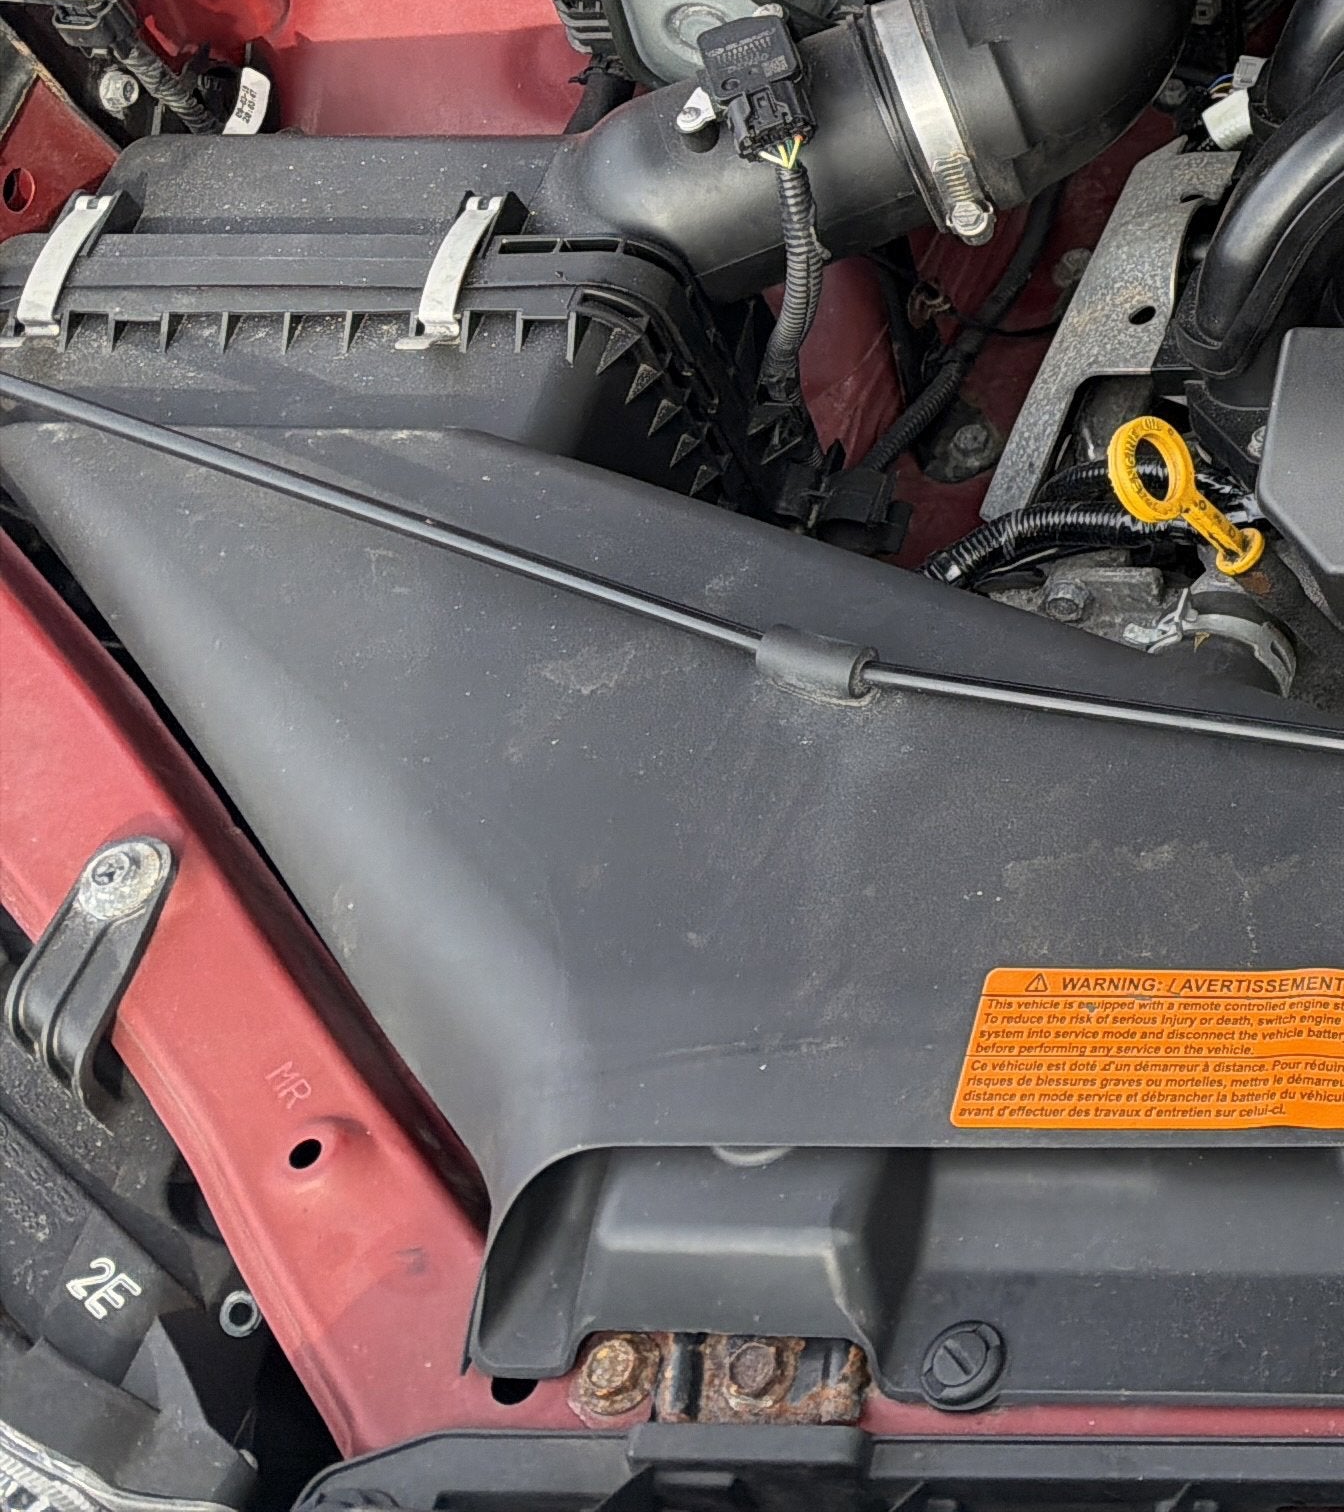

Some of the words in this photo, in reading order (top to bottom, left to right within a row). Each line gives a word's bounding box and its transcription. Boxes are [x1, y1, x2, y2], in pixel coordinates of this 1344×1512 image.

[1062, 977, 1163, 992] WARNING:
[987, 999, 1014, 1010] This
[1017, 999, 1060, 1010] vehicle
[1063, 1000, 1075, 1010] is
[1078, 999, 1136, 1012] euipped
[1138, 1000, 1164, 1011] with
[1178, 1001, 1222, 1012] remote
[1224, 1001, 1286, 1012] controlled
[1288, 999, 1331, 1013] engine
[983, 1013, 999, 1024] To
[1001, 1014, 1044, 1025] reduce
[1047, 1014, 1066, 1025] the
[1069, 1014, 1093, 1025] risk
[1096, 1014, 1110, 1025] of
[1112, 1014, 1158, 1026] serious
[1199, 1017, 1212, 1027] or
[1216, 1016, 1254, 1028] death,
[1257, 1014, 1296, 1026] switch
[1299, 1014, 1341, 1028] engine
[979, 1029, 1024, 1042] system
[1027, 1029, 1051, 1040] into
[1054, 1029, 1099, 1040] service
[1102, 1029, 1137, 1040] mode
[1140, 1029, 1164, 1040] and
[1167, 1030, 1236, 1041] disconnect
[1238, 1030, 1259, 1041] the
[1262, 1028, 1304, 1040] vehicle
[975, 1043, 1015, 1055] before
[1018, 1044, 1087, 1057] performing
[1090, 1045, 1113, 1057] any
[1115, 1044, 1161, 1055] service
[1164, 1045, 1181, 1055] on
[1184, 1045, 1204, 1055] the
[1207, 1044, 1255, 1056] vehicle.
[971, 1059, 988, 1071] Ce
[991, 1060, 1044, 1072] véhicule
[1047, 1061, 1066, 1072] est
[1069, 1060, 1098, 1072] doté
[1102, 1060, 1131, 1072] d'un
[1134, 1060, 1200, 1073] démarreur
[1213, 1060, 1269, 1074] distance.
[1271, 1059, 1302, 1072] Pour
[265, 1060, 312, 1108] MR
[966, 1075, 1013, 1088] risques
[1017, 1075, 1032, 1087] de
[1036, 1075, 1097, 1087] blessures
[1100, 1076, 1143, 1089] graves
[1146, 1077, 1163, 1088] ou
[1165, 1076, 1227, 1089] mortelles,
[1230, 1077, 1269, 1088] mettre
[1272, 1075, 1283, 1086] le
[962, 1090, 1017, 1102] distance
[1020, 1092, 1035, 1102] en
[1038, 1090, 1074, 1102] mode
[1077, 1091, 1123, 1103] service
[1126, 1091, 1138, 1103] et
[1141, 1090, 1213, 1103] débrancher
[1216, 1090, 1227, 1103] la
[1231, 1090, 1277, 1103] batterie
[1280, 1088, 1297, 1100] du
[959, 1106, 994, 1118] avant
[997, 1105, 1065, 1118] d'effectuer
[1068, 1105, 1091, 1118] des
[1094, 1106, 1141, 1118] travaux
[1144, 1105, 1212, 1118] d'entretien
[1215, 1107, 1237, 1118] sur
[66, 1257, 141, 1319] 2E
